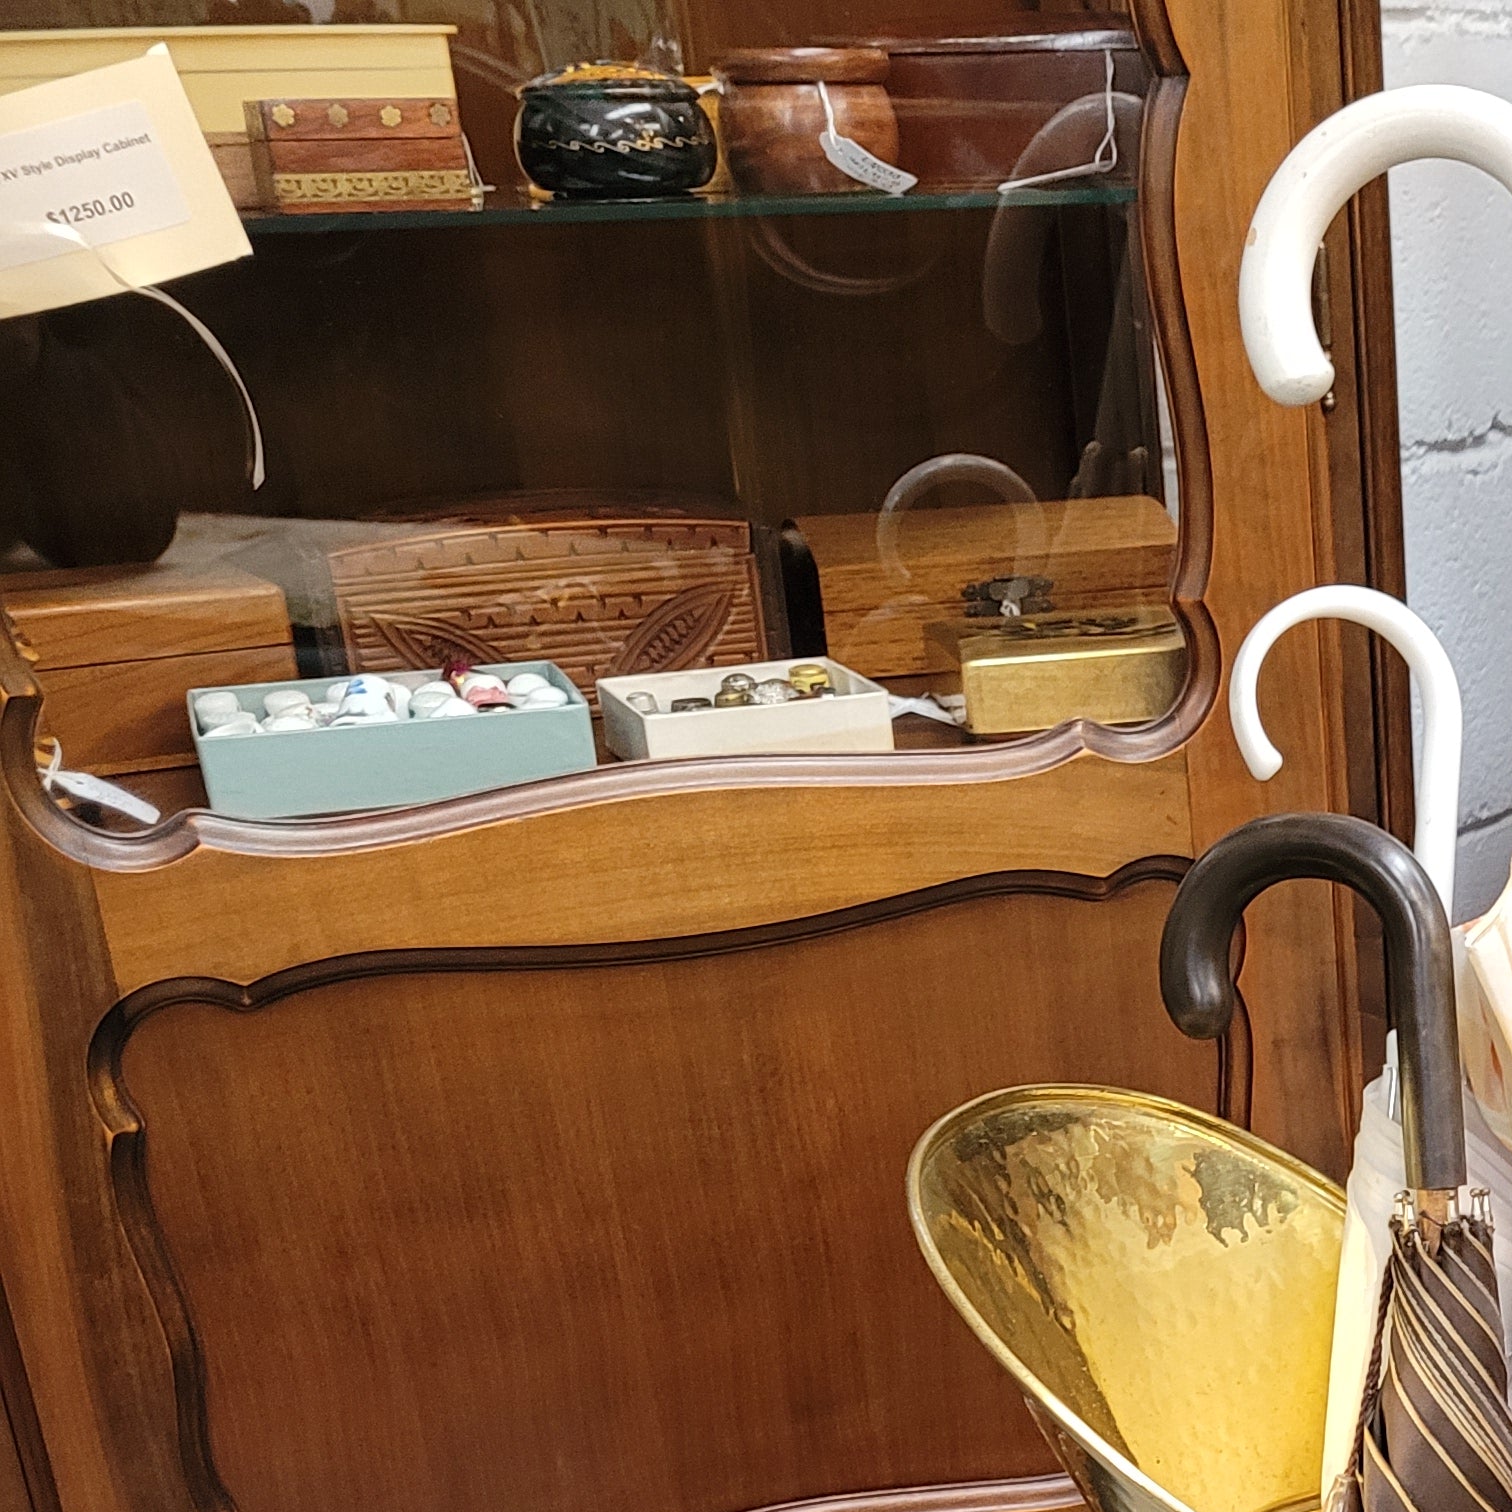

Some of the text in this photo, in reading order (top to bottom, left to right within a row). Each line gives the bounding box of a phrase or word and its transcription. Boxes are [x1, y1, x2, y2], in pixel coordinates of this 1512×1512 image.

[0, 133, 152, 181] XV Style Display Cabinet
[45, 191, 135, 225] $1250.00
